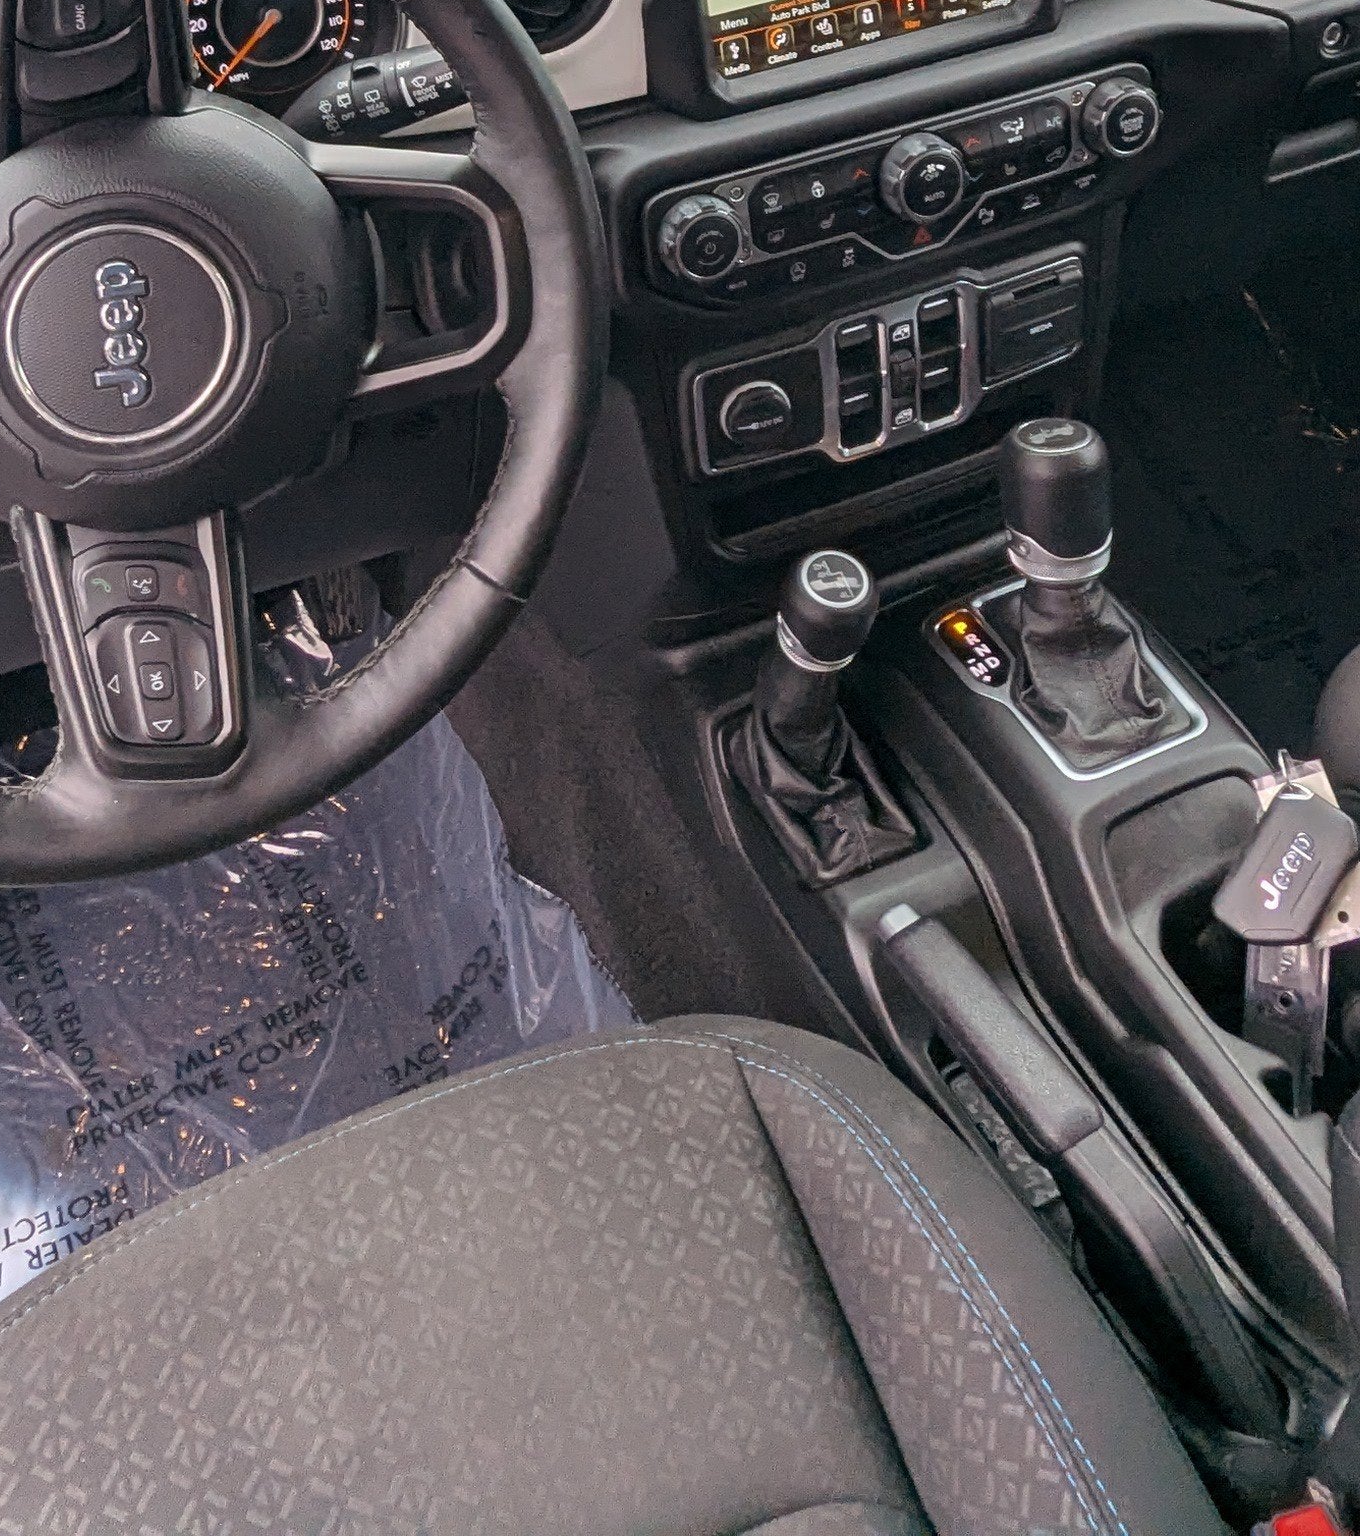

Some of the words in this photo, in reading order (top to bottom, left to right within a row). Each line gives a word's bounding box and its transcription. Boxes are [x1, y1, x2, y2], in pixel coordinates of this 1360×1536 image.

[771, 10, 790, 23] Auto
[792, 5, 811, 18] Park
[812, 0, 831, 12] Blvd
[942, 8, 967, 20] Phone
[189, 18, 207, 33] 20
[329, 15, 344, 27] 110
[720, 17, 749, 31] Menu
[860, 29, 881, 42] Apps
[202, 45, 215, 56] 10
[320, 37, 339, 51] 120
[811, 38, 844, 53] Controls
[767, 51, 798, 65] Climate
[724, 62, 751, 76] Media
[228, 72, 249, 83] MPH
[1046, 115, 1062, 127] A/C
[94, 256, 152, 409] Jeep
[964, 633, 981, 646] R
[974, 643, 992, 657] N
[984, 656, 1001, 669] D
[150, 670, 165, 691] OK
[1260, 832, 1315, 910] Jeep
[262, 962, 369, 1033] REMOVE
[238, 1018, 328, 1075] COVER
